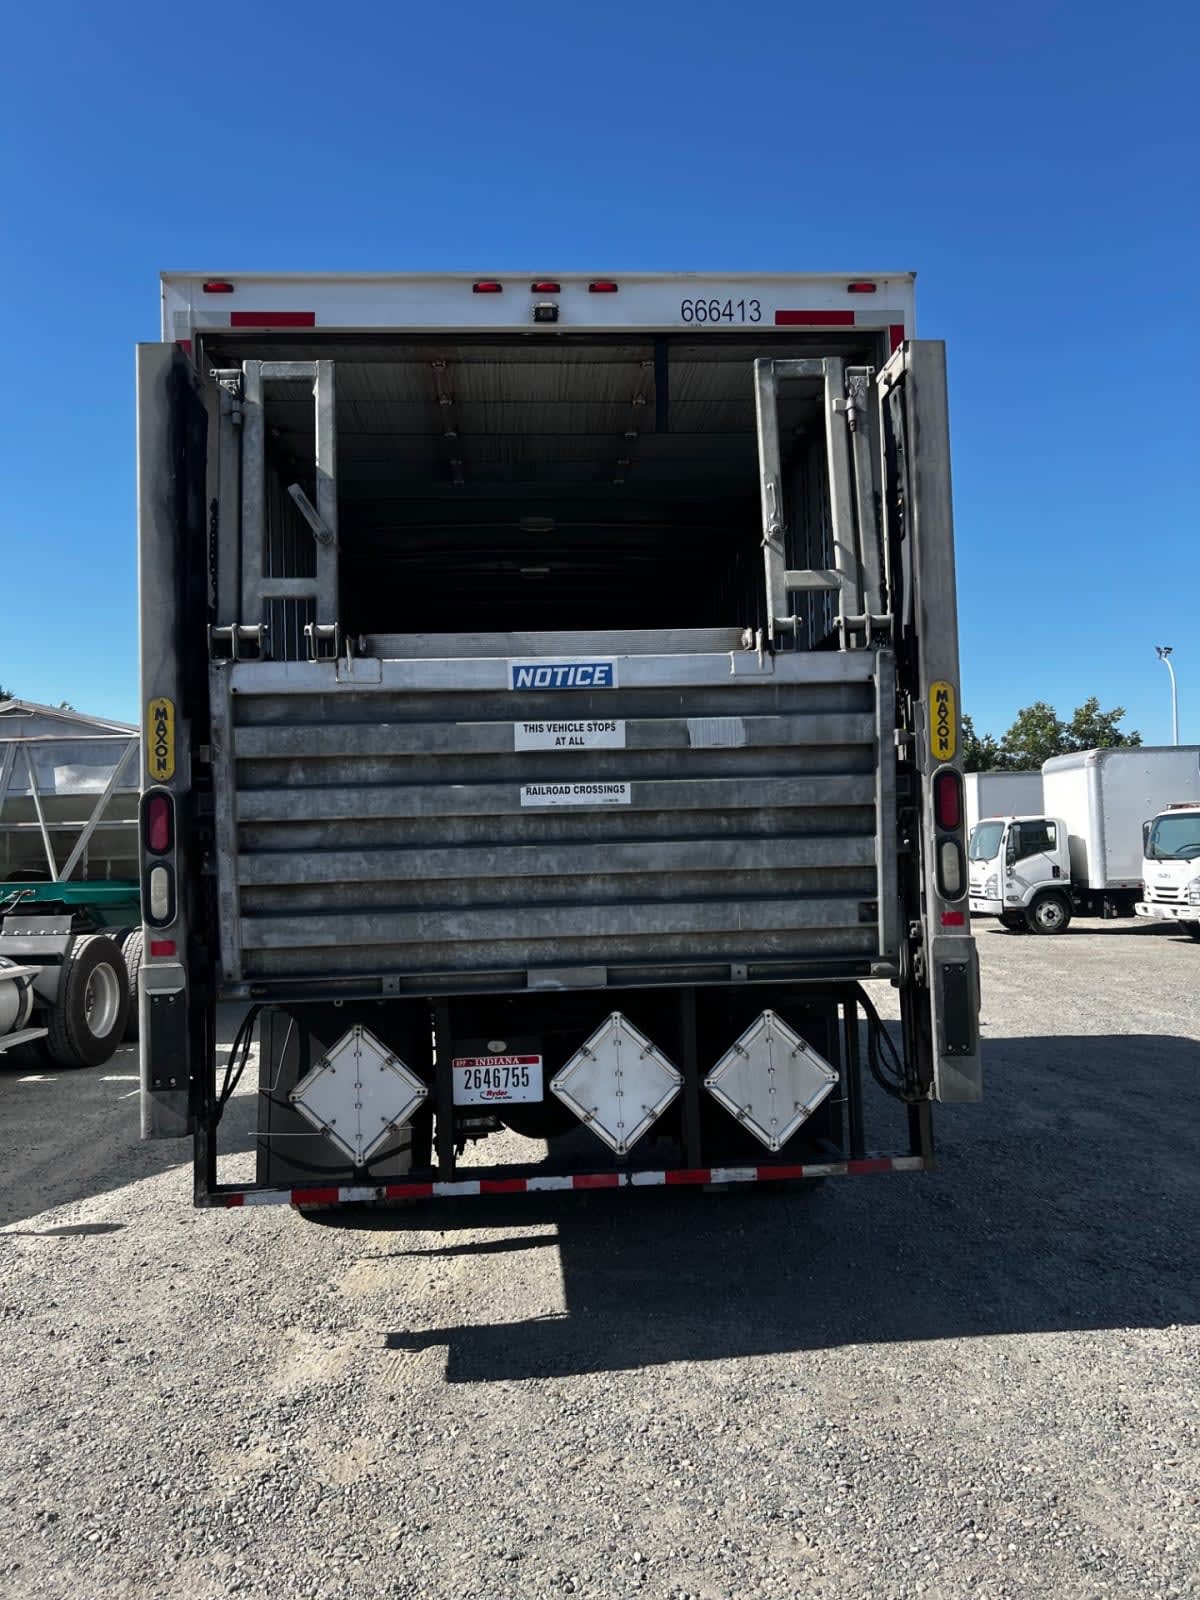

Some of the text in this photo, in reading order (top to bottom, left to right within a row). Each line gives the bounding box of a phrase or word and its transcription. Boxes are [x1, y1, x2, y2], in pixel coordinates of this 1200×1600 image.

[681, 299, 762, 322] 666413
[516, 666, 609, 688] NOTICE
[523, 722, 616, 733] THIS VEHICLE STOPS
[936, 689, 950, 751] MAXON
[154, 707, 169, 771] MAXON
[555, 736, 585, 746] AT ALL
[526, 784, 625, 796] RAILROAD CROSSINGS
[475, 1057, 520, 1066] INDIANA
[464, 1067, 530, 1090] 2646755
